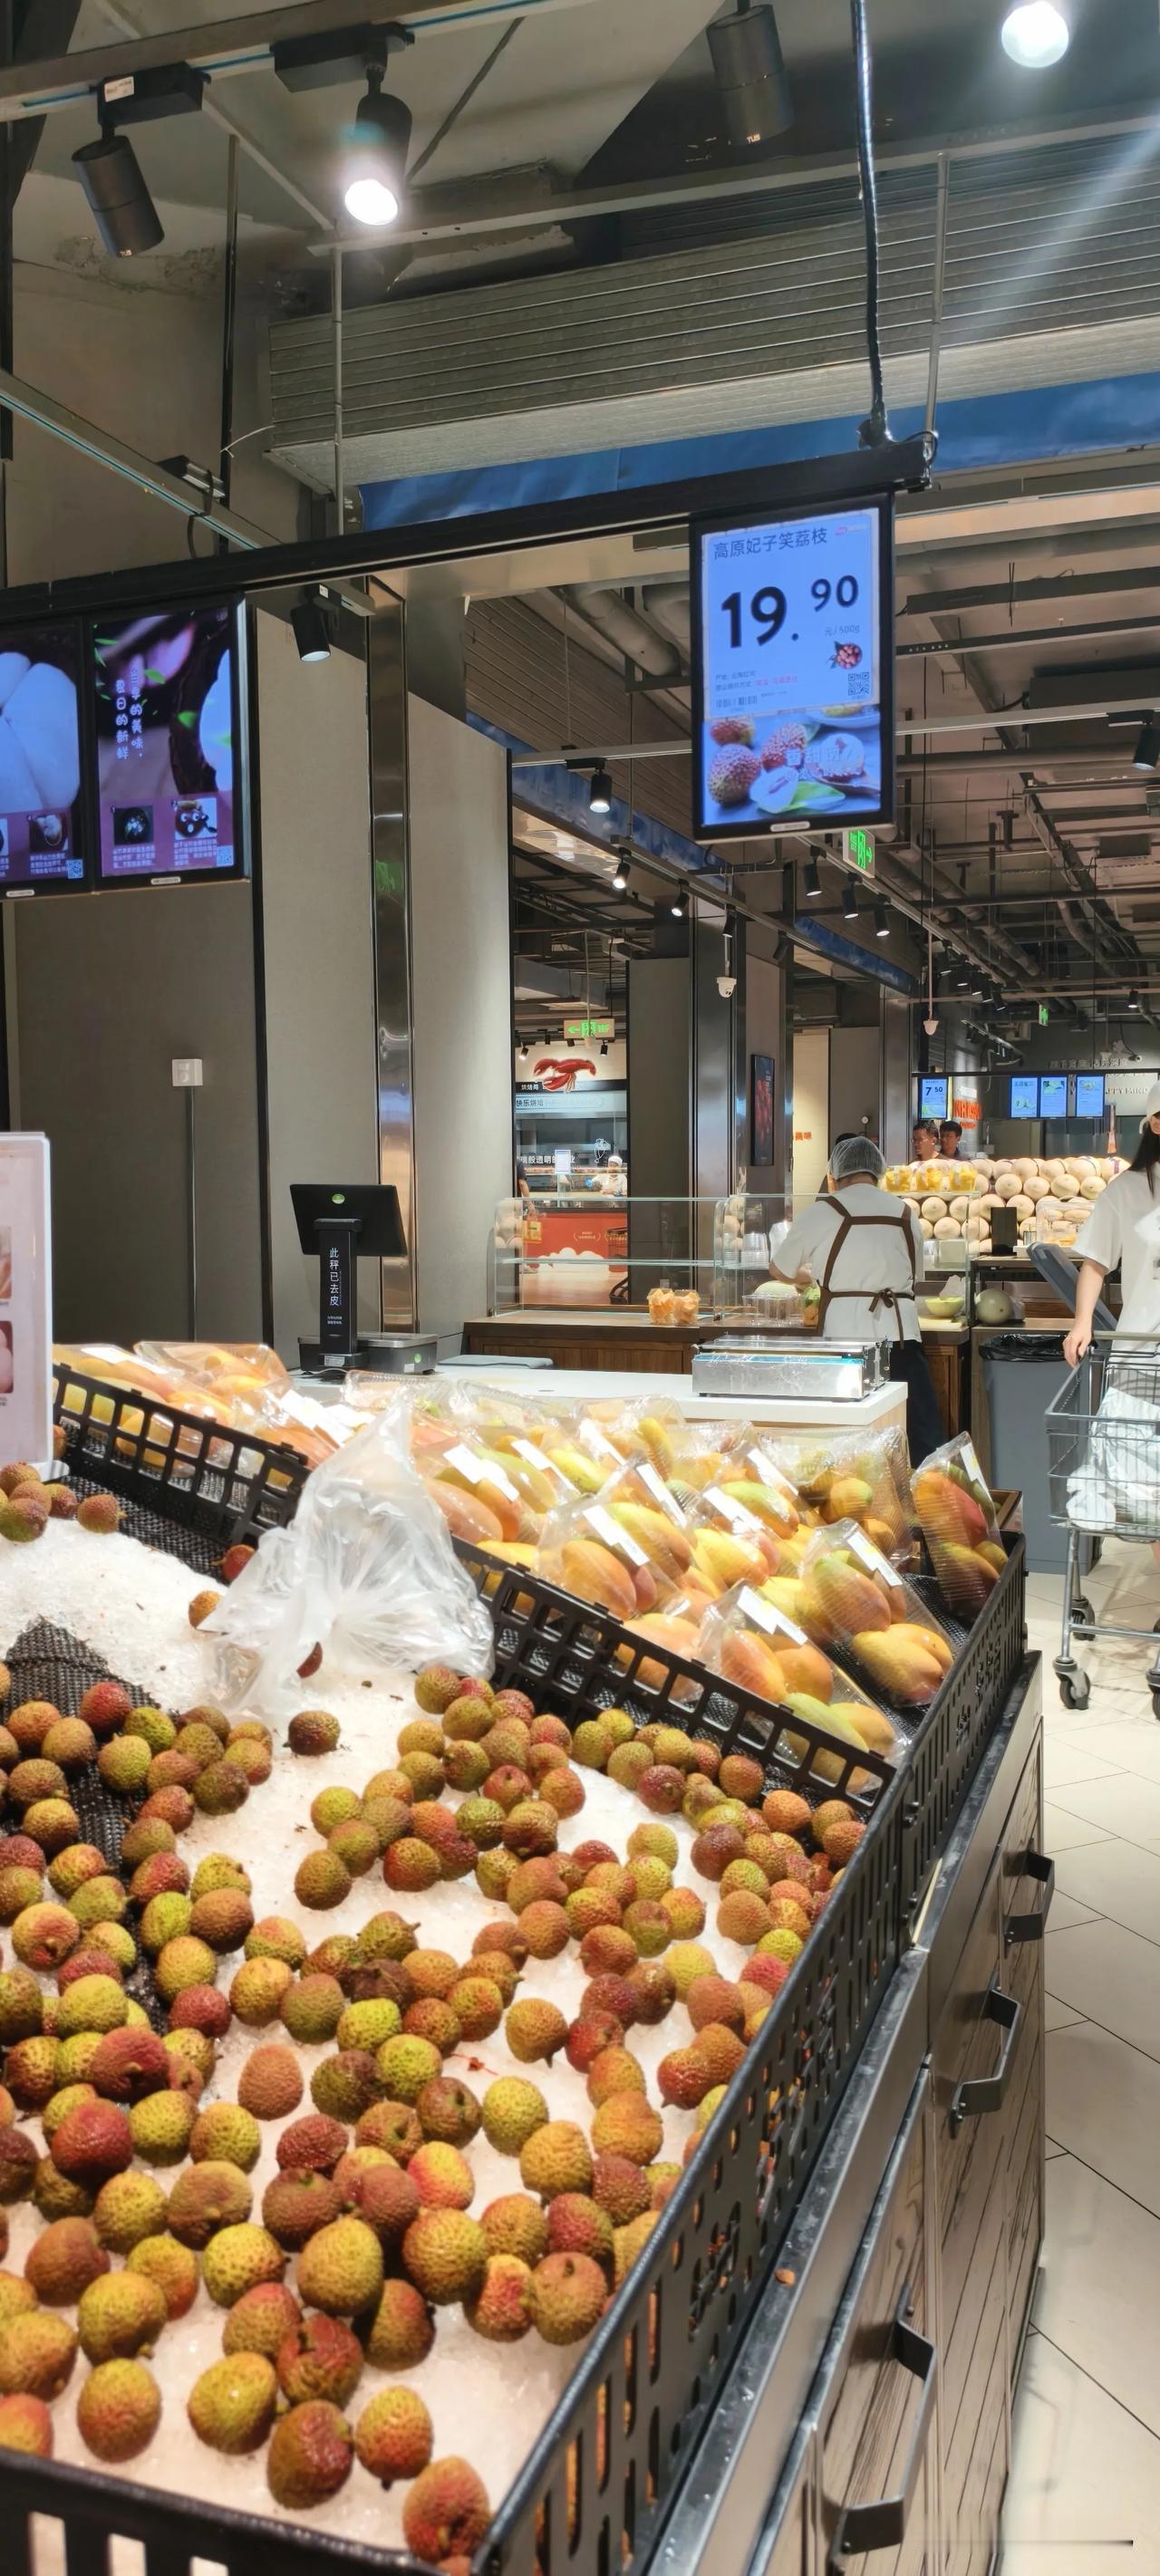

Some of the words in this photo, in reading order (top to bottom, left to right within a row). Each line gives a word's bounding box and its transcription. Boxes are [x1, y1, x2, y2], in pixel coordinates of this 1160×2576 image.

[714, 527, 826, 560] 高原妃子笑荔枝
[811, 575, 858, 612] 90
[329, 1247, 339, 1306] 此秤已去皮
